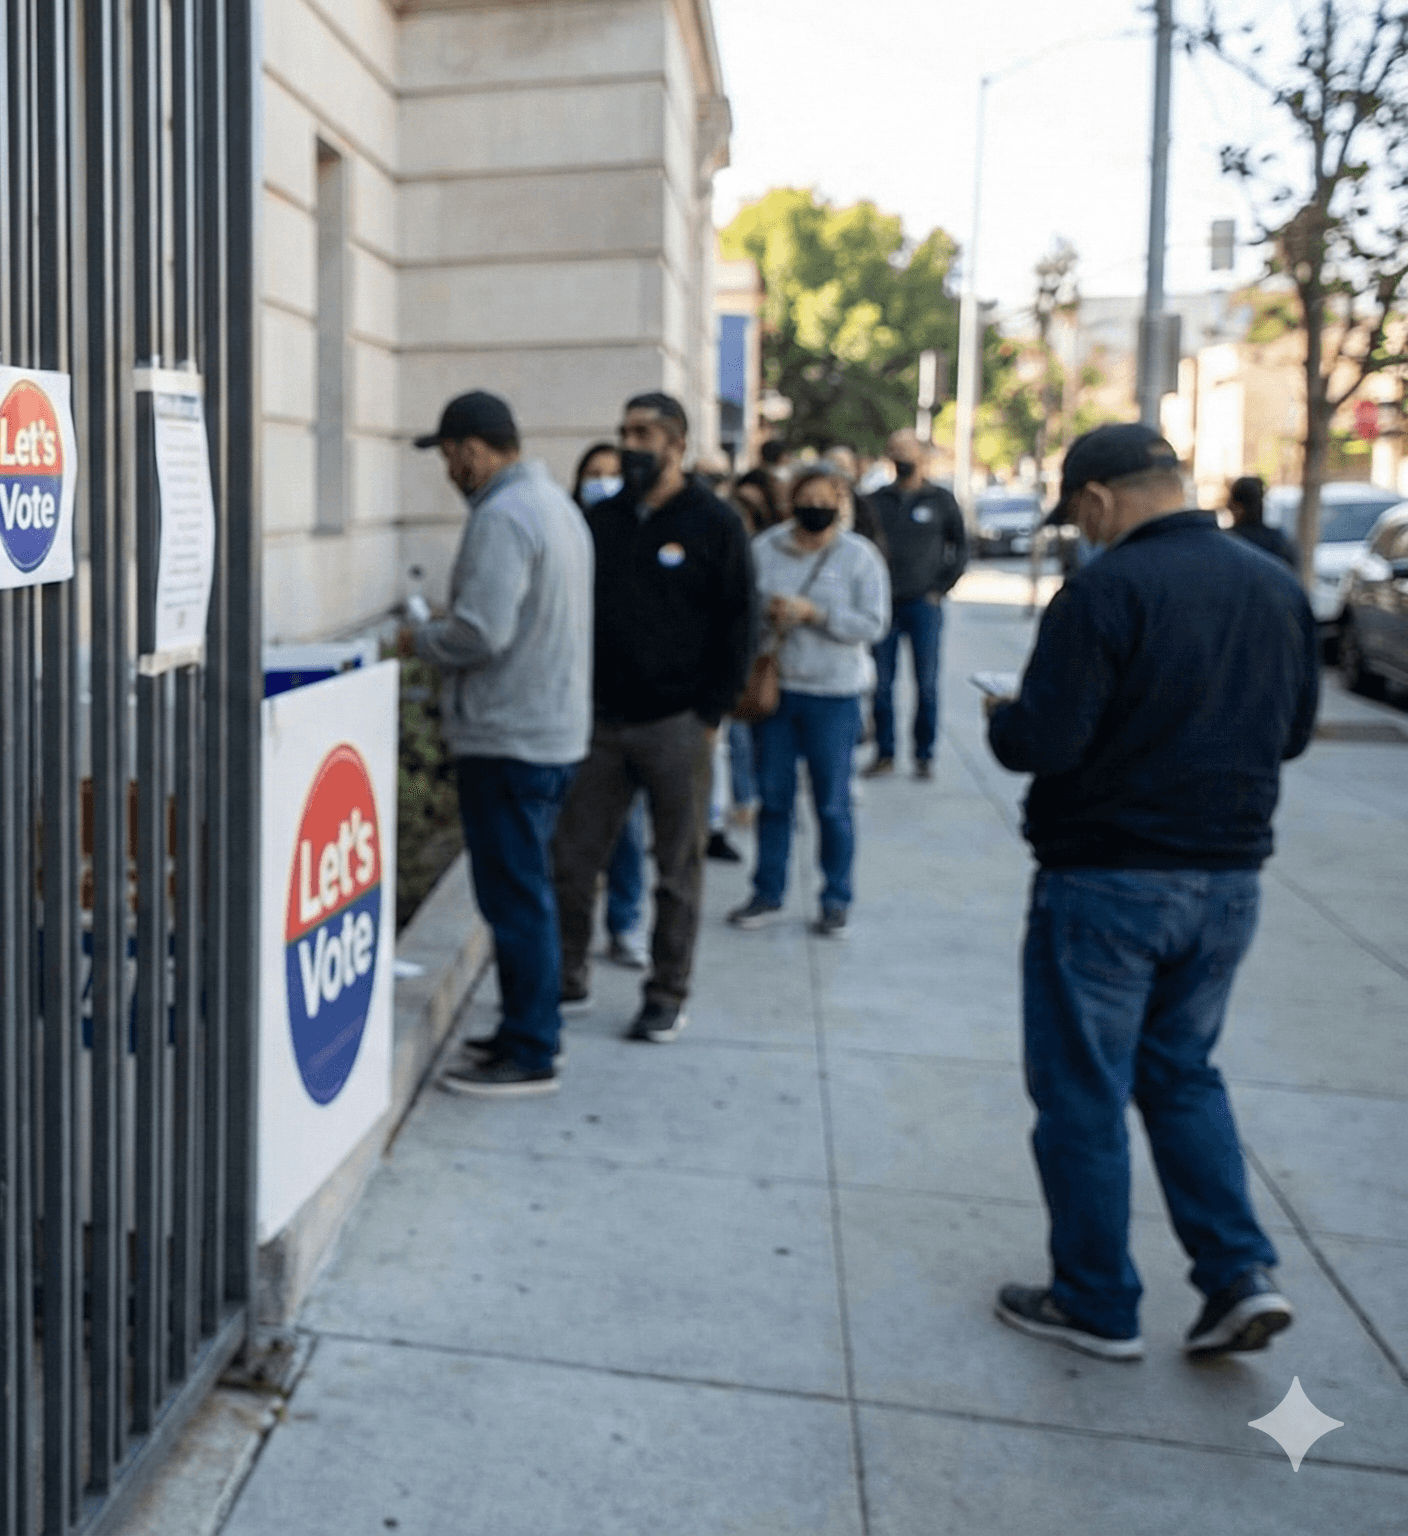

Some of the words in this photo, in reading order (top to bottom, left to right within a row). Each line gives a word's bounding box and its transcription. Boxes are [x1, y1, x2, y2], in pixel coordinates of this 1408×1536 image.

[0, 417, 57, 466] Let's
[299, 808, 375, 924] Let's
[298, 911, 373, 1019] Vote
